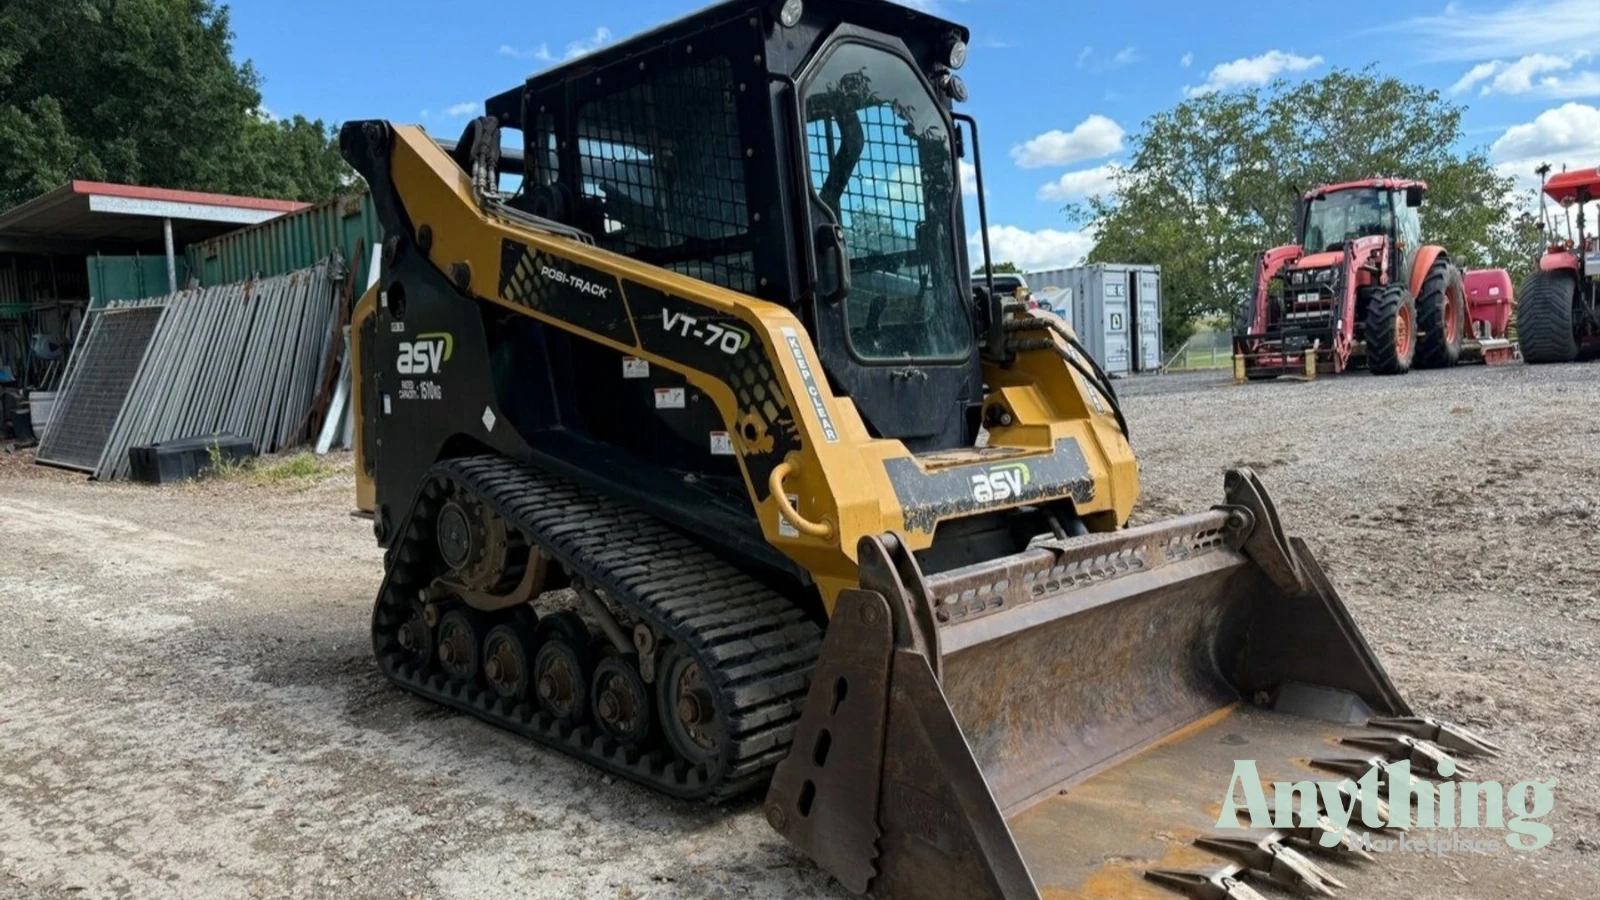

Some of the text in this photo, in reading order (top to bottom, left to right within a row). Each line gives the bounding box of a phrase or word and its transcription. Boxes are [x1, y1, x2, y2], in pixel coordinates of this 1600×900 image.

[541, 265, 608, 298] POSI-TRACK
[662, 307, 742, 355] VT-70
[788, 336, 837, 440] KEEP CLEAR
